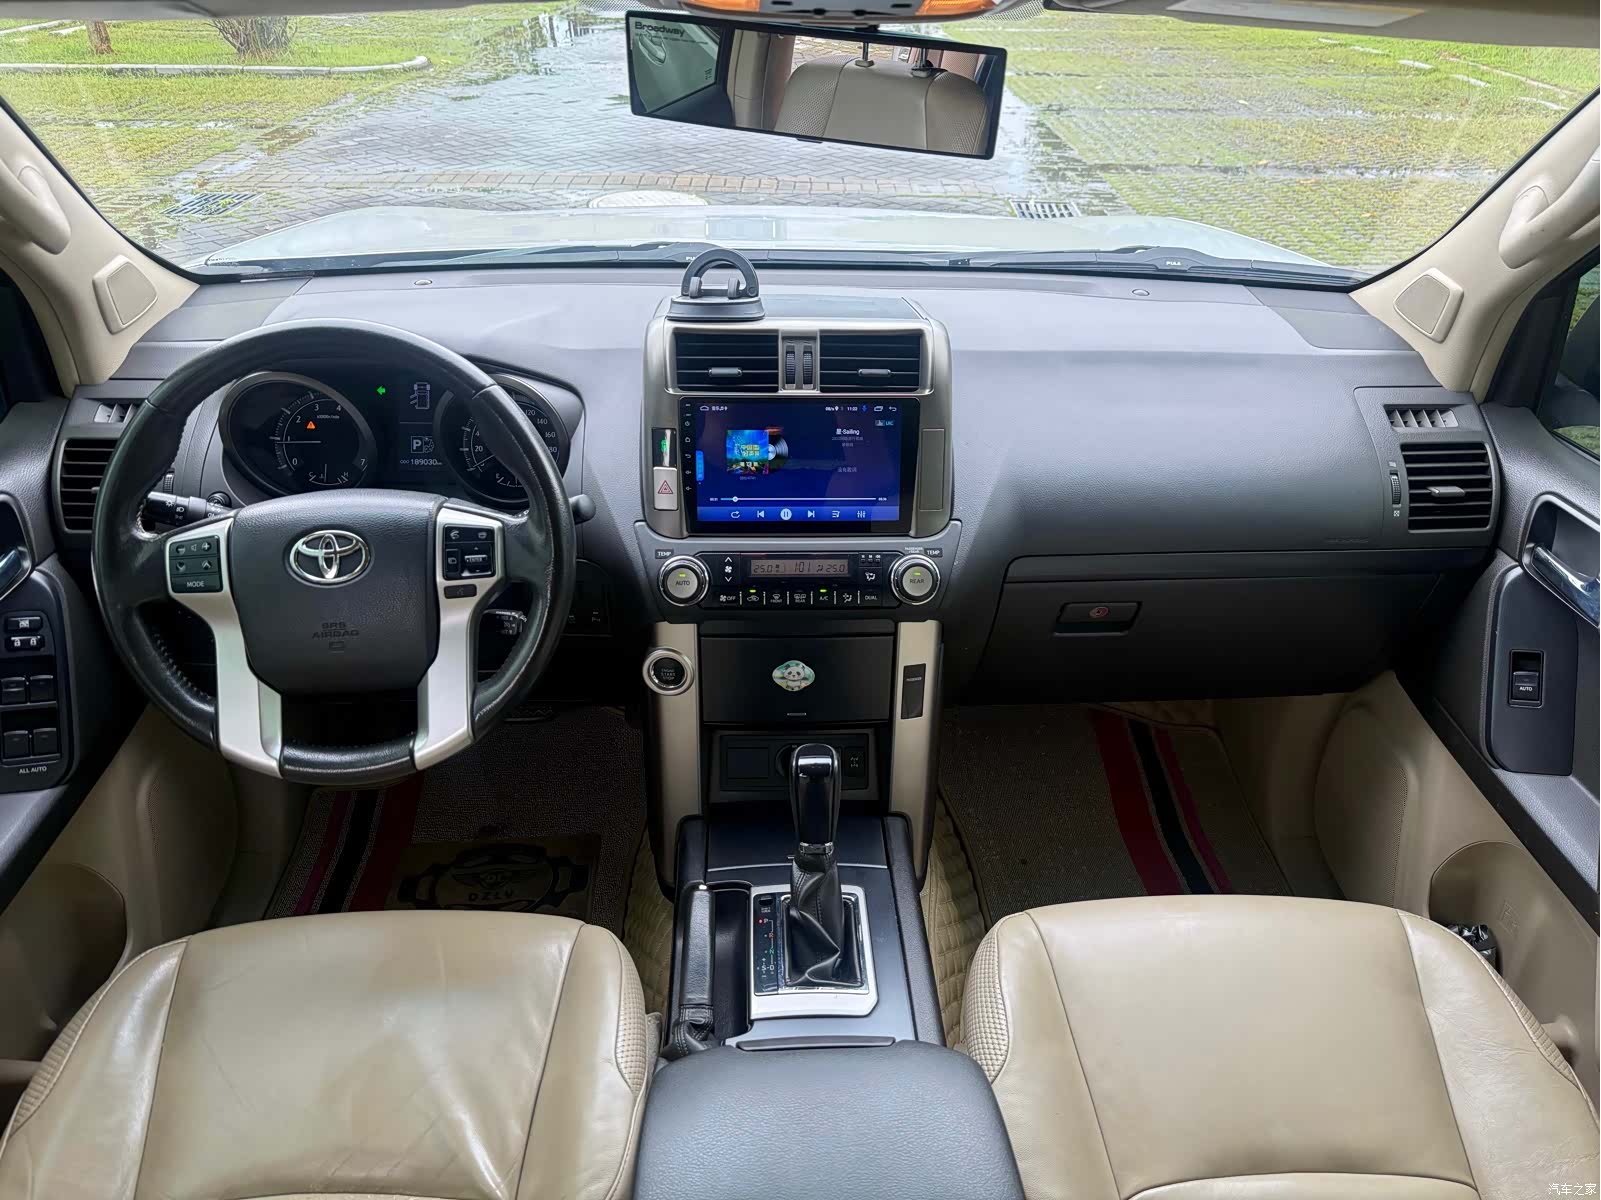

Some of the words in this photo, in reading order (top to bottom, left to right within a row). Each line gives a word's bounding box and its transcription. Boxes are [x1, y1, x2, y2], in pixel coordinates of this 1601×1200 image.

[635, 21, 685, 37] Broadway
[315, 403, 319, 411] 3
[296, 415, 301, 423] 2
[292, 458, 298, 466] 0
[360, 458, 366, 466] 7
